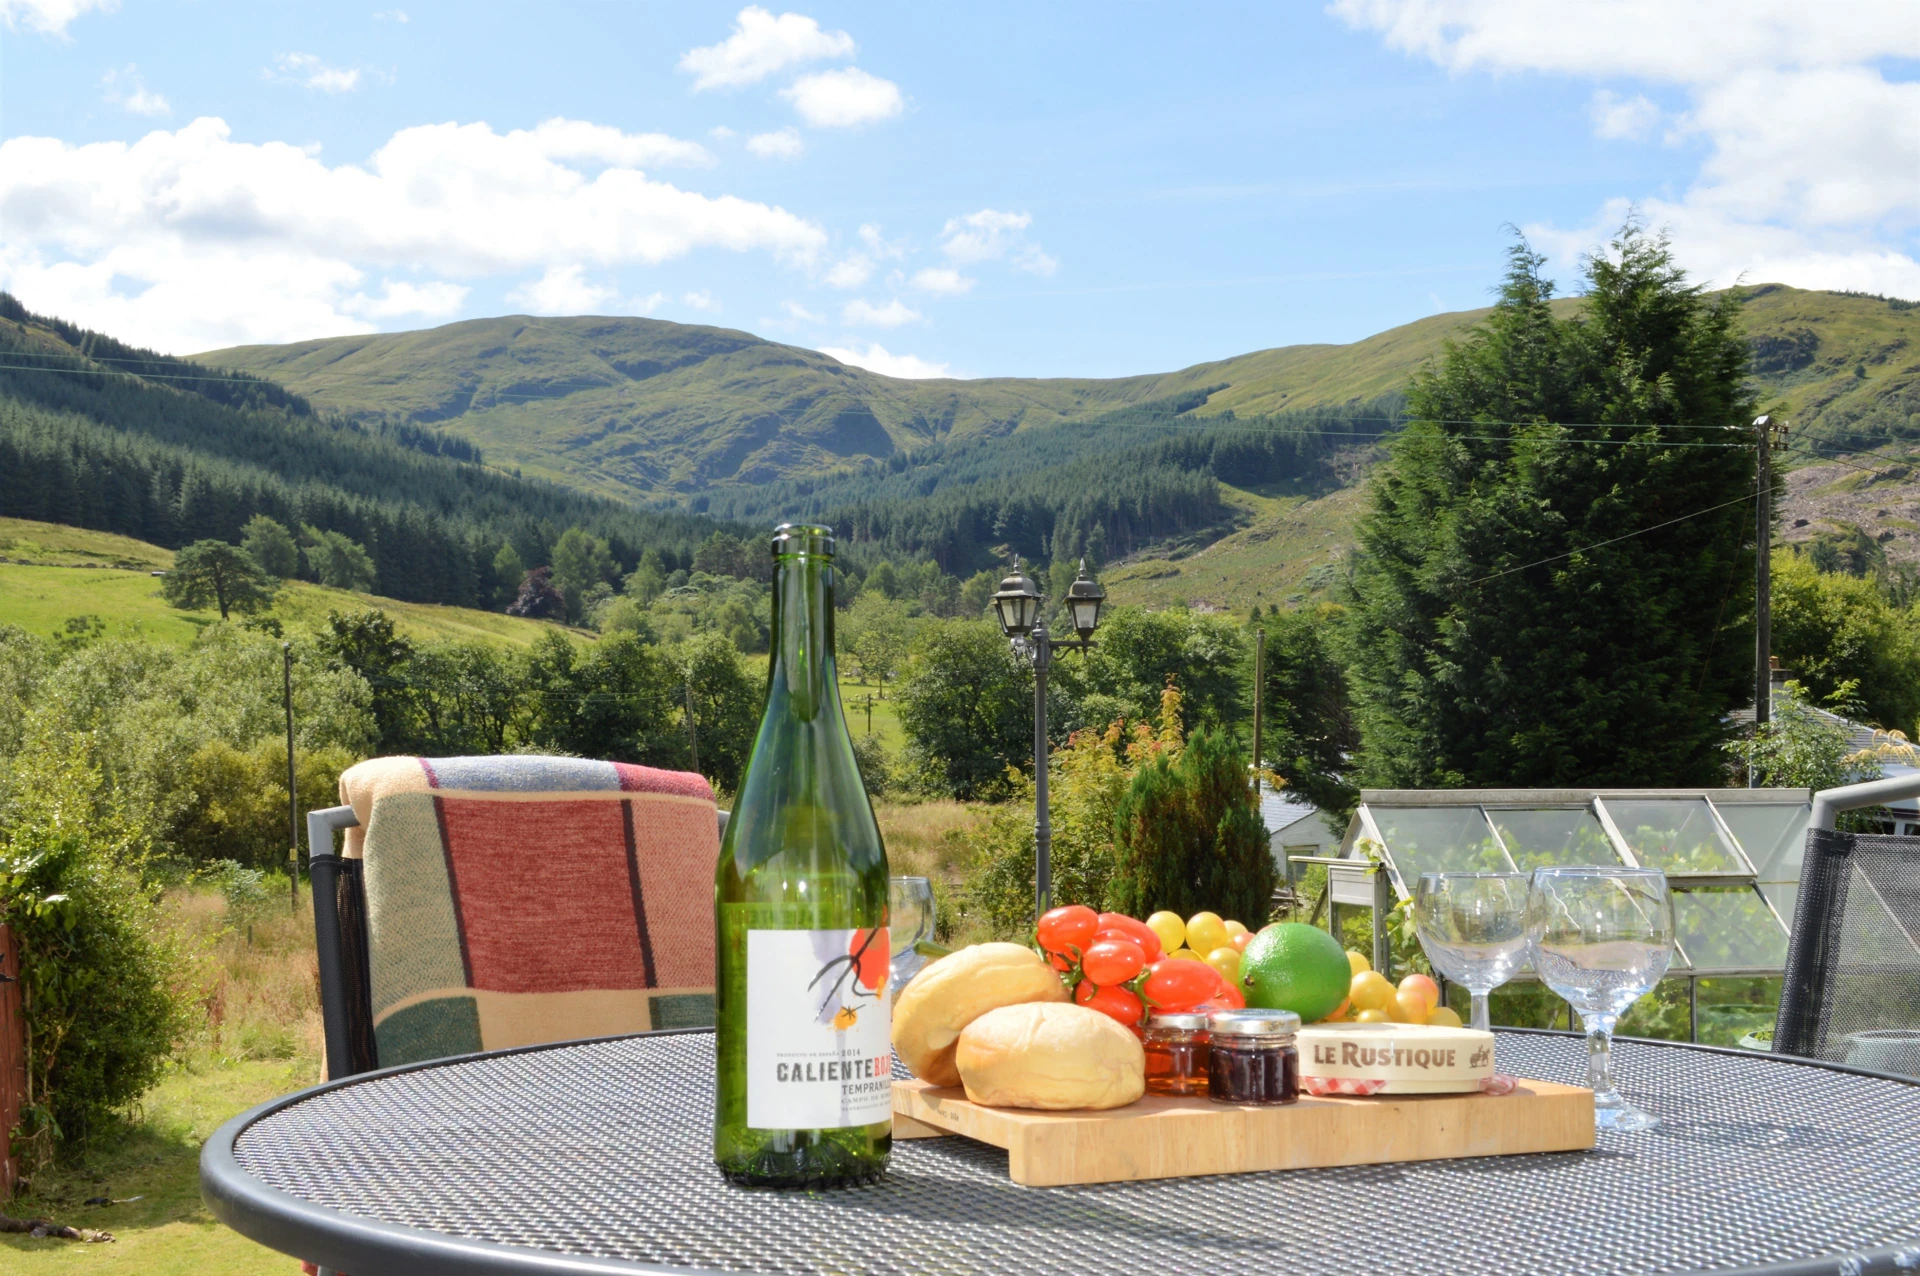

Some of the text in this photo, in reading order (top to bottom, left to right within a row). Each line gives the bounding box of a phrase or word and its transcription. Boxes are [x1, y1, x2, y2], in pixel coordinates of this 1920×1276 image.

[841, 1048, 860, 1057] 2014
[1314, 1041, 1456, 1069] LE RUSTIQUE
[776, 1058, 873, 1083] CALIENTE
